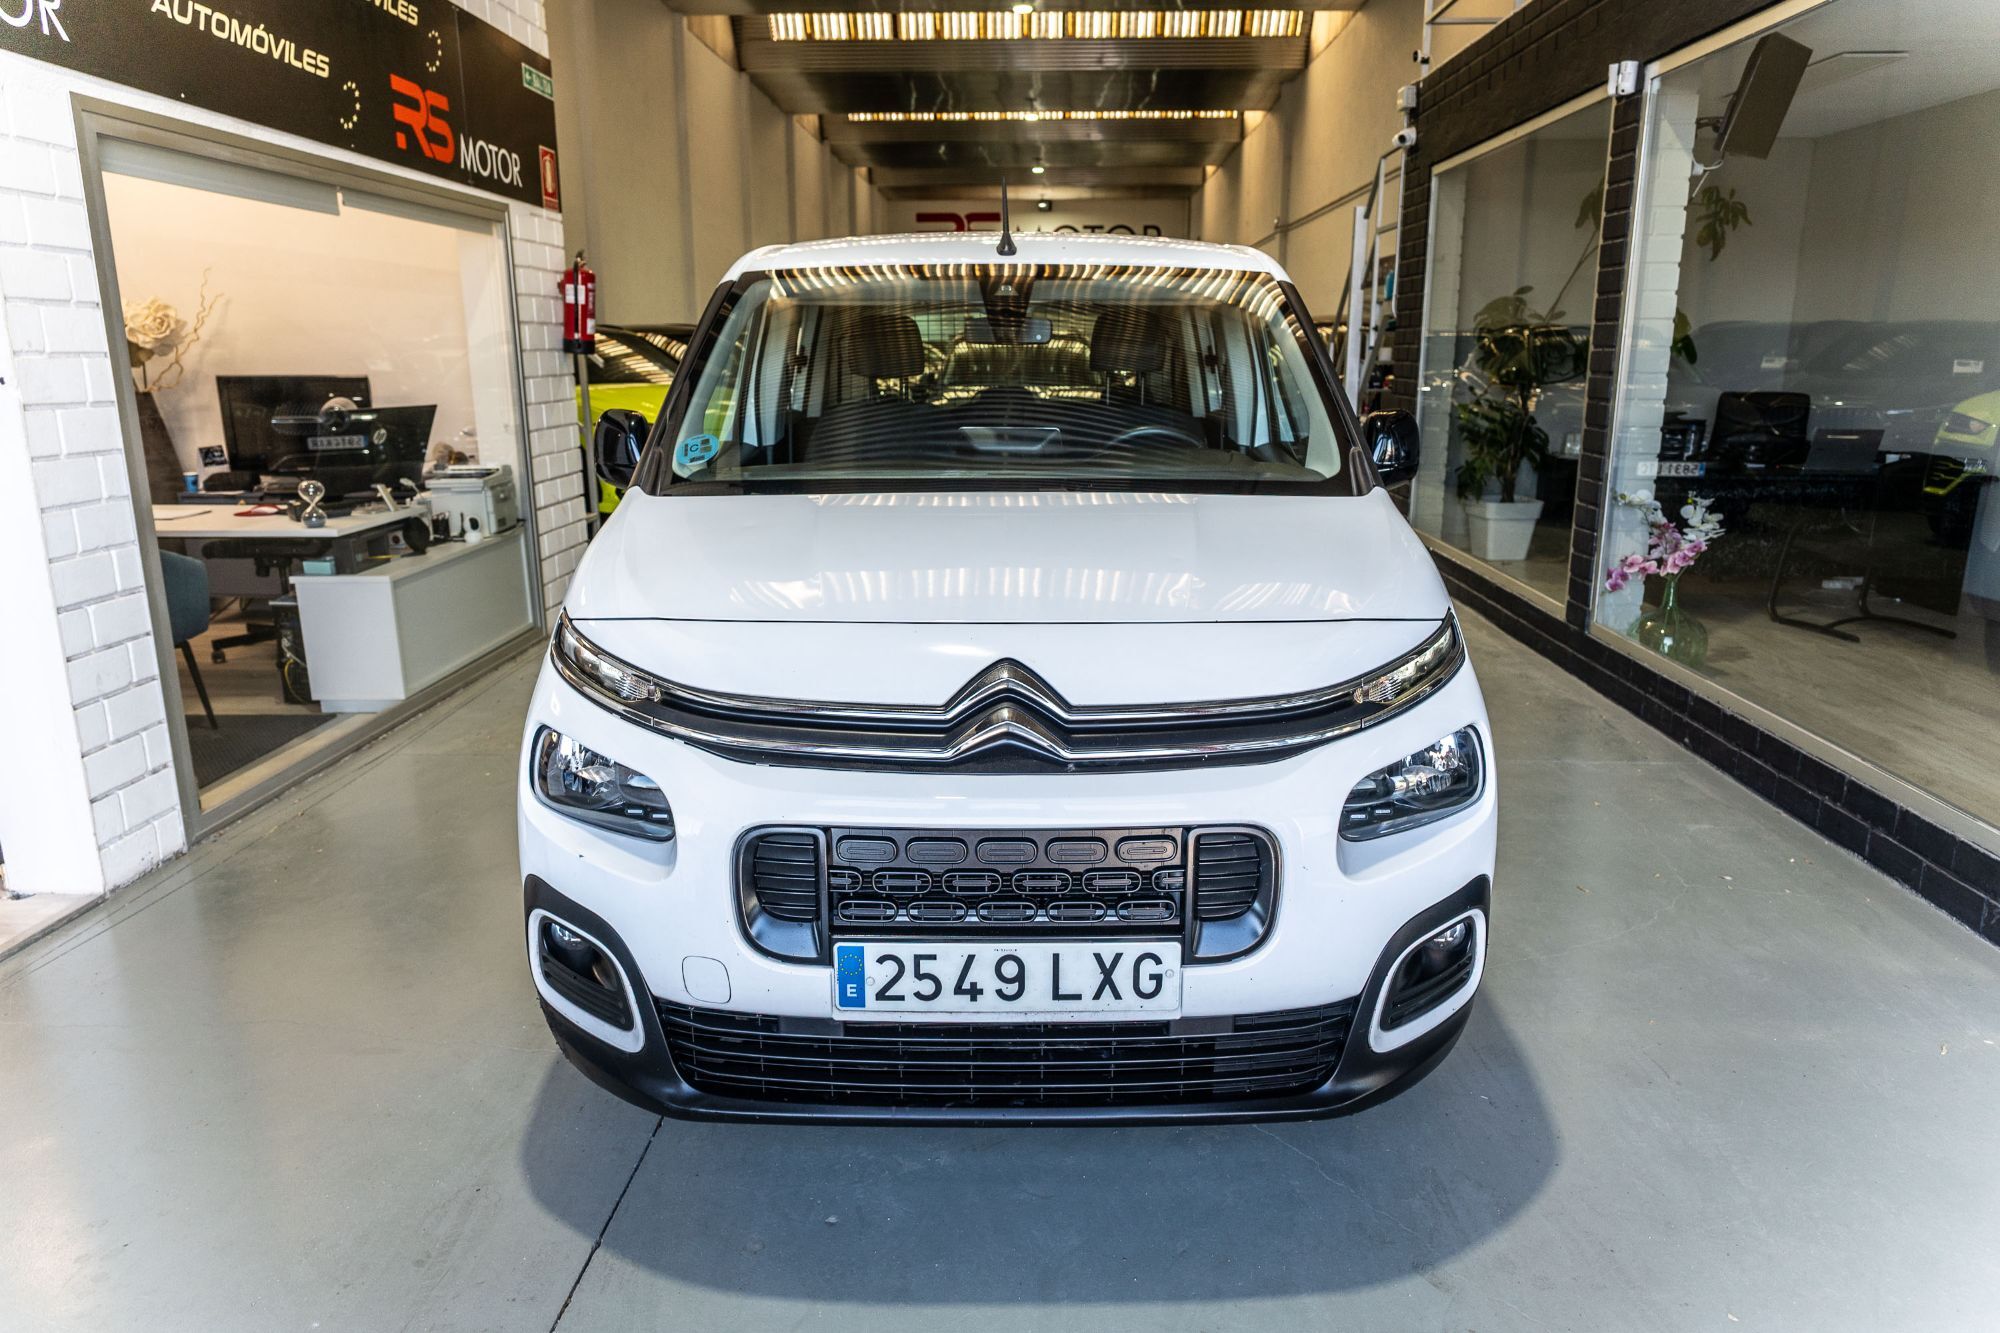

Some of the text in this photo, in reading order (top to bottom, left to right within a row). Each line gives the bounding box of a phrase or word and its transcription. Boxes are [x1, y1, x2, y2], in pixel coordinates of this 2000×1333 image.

[151, 0, 330, 78] AUTOMÓVILES
[389, 73, 523, 188] RS MOTOR
[847, 983, 858, 997] E
[875, 952, 1163, 1002] 2549 LXG
